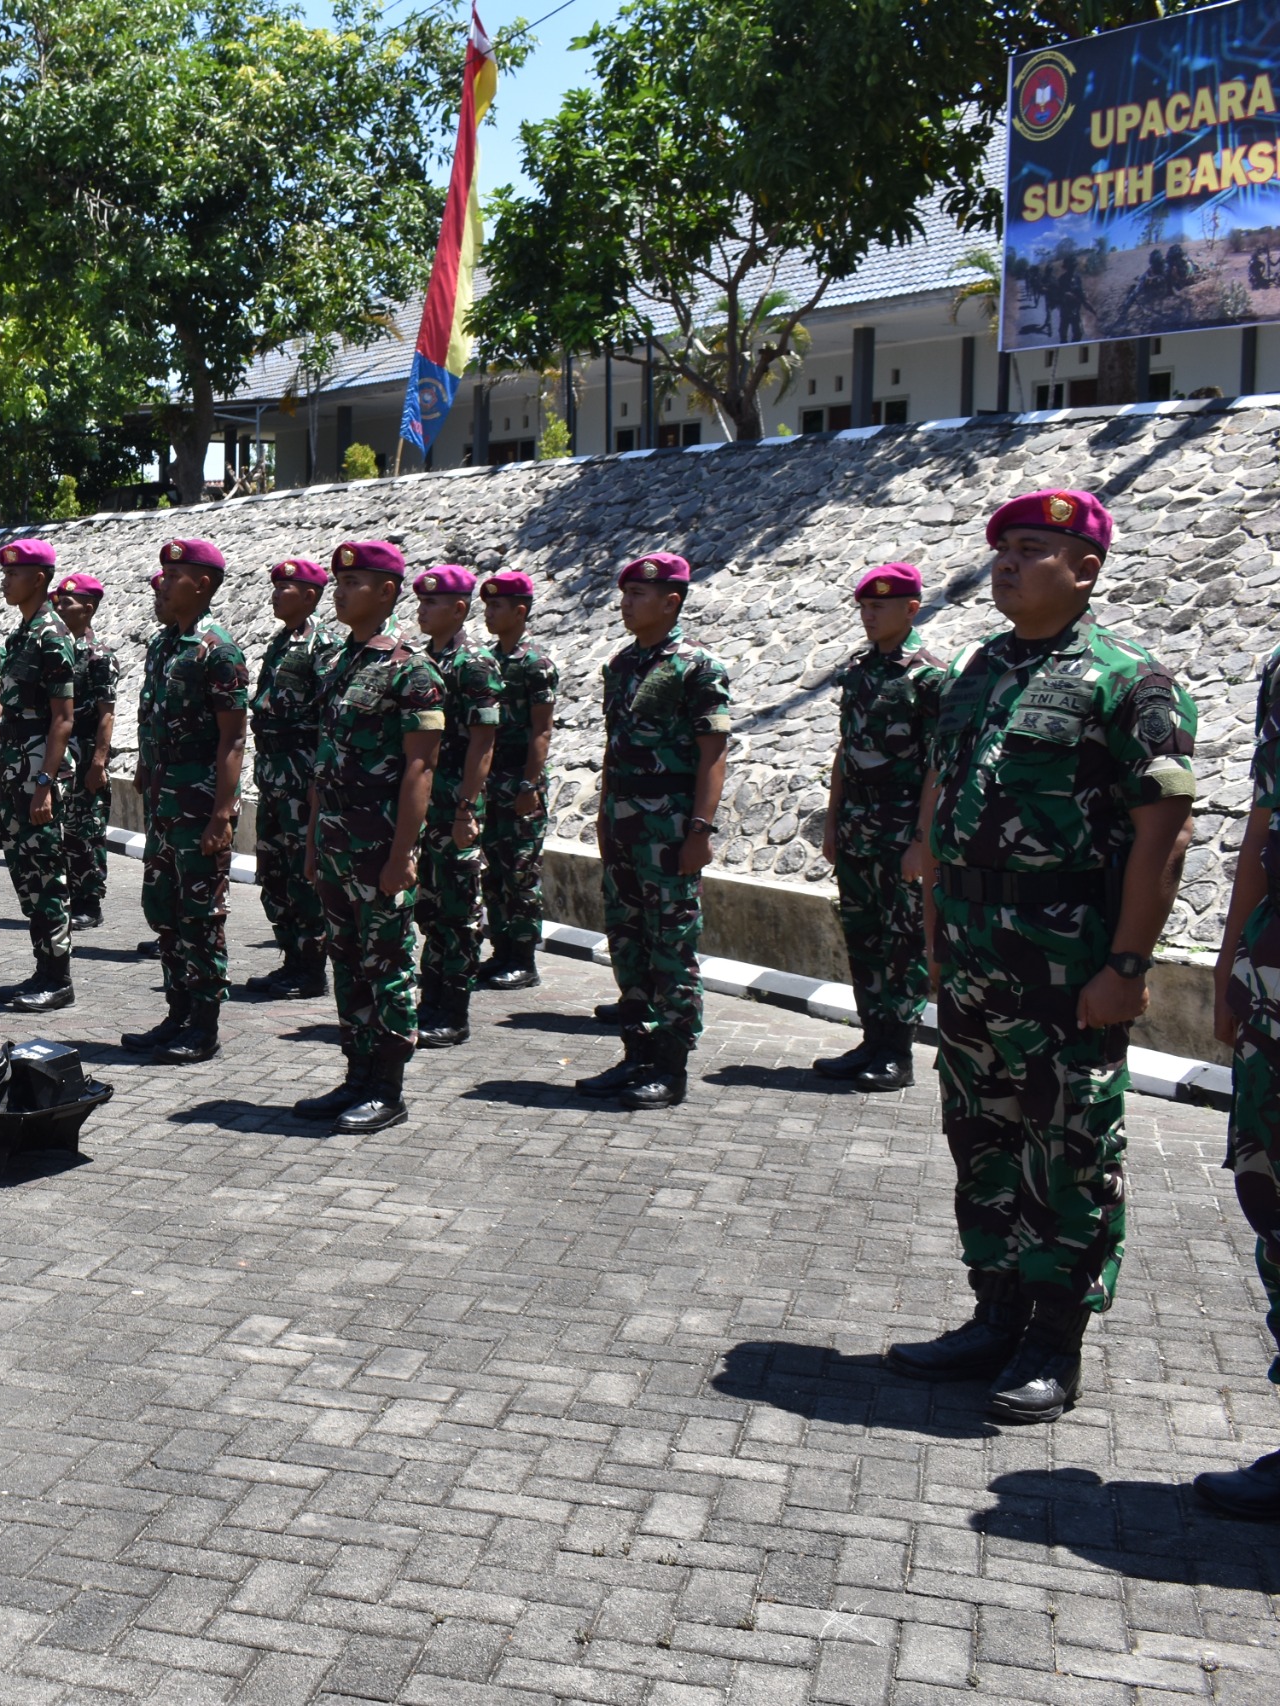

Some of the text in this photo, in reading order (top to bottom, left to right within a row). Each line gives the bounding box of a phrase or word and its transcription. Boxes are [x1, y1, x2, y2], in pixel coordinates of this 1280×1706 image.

[1090, 73, 1276, 149] UPACARA
[1021, 138, 1280, 222] SUSTIH BAKS
[1030, 693, 1080, 709] TNI AL
